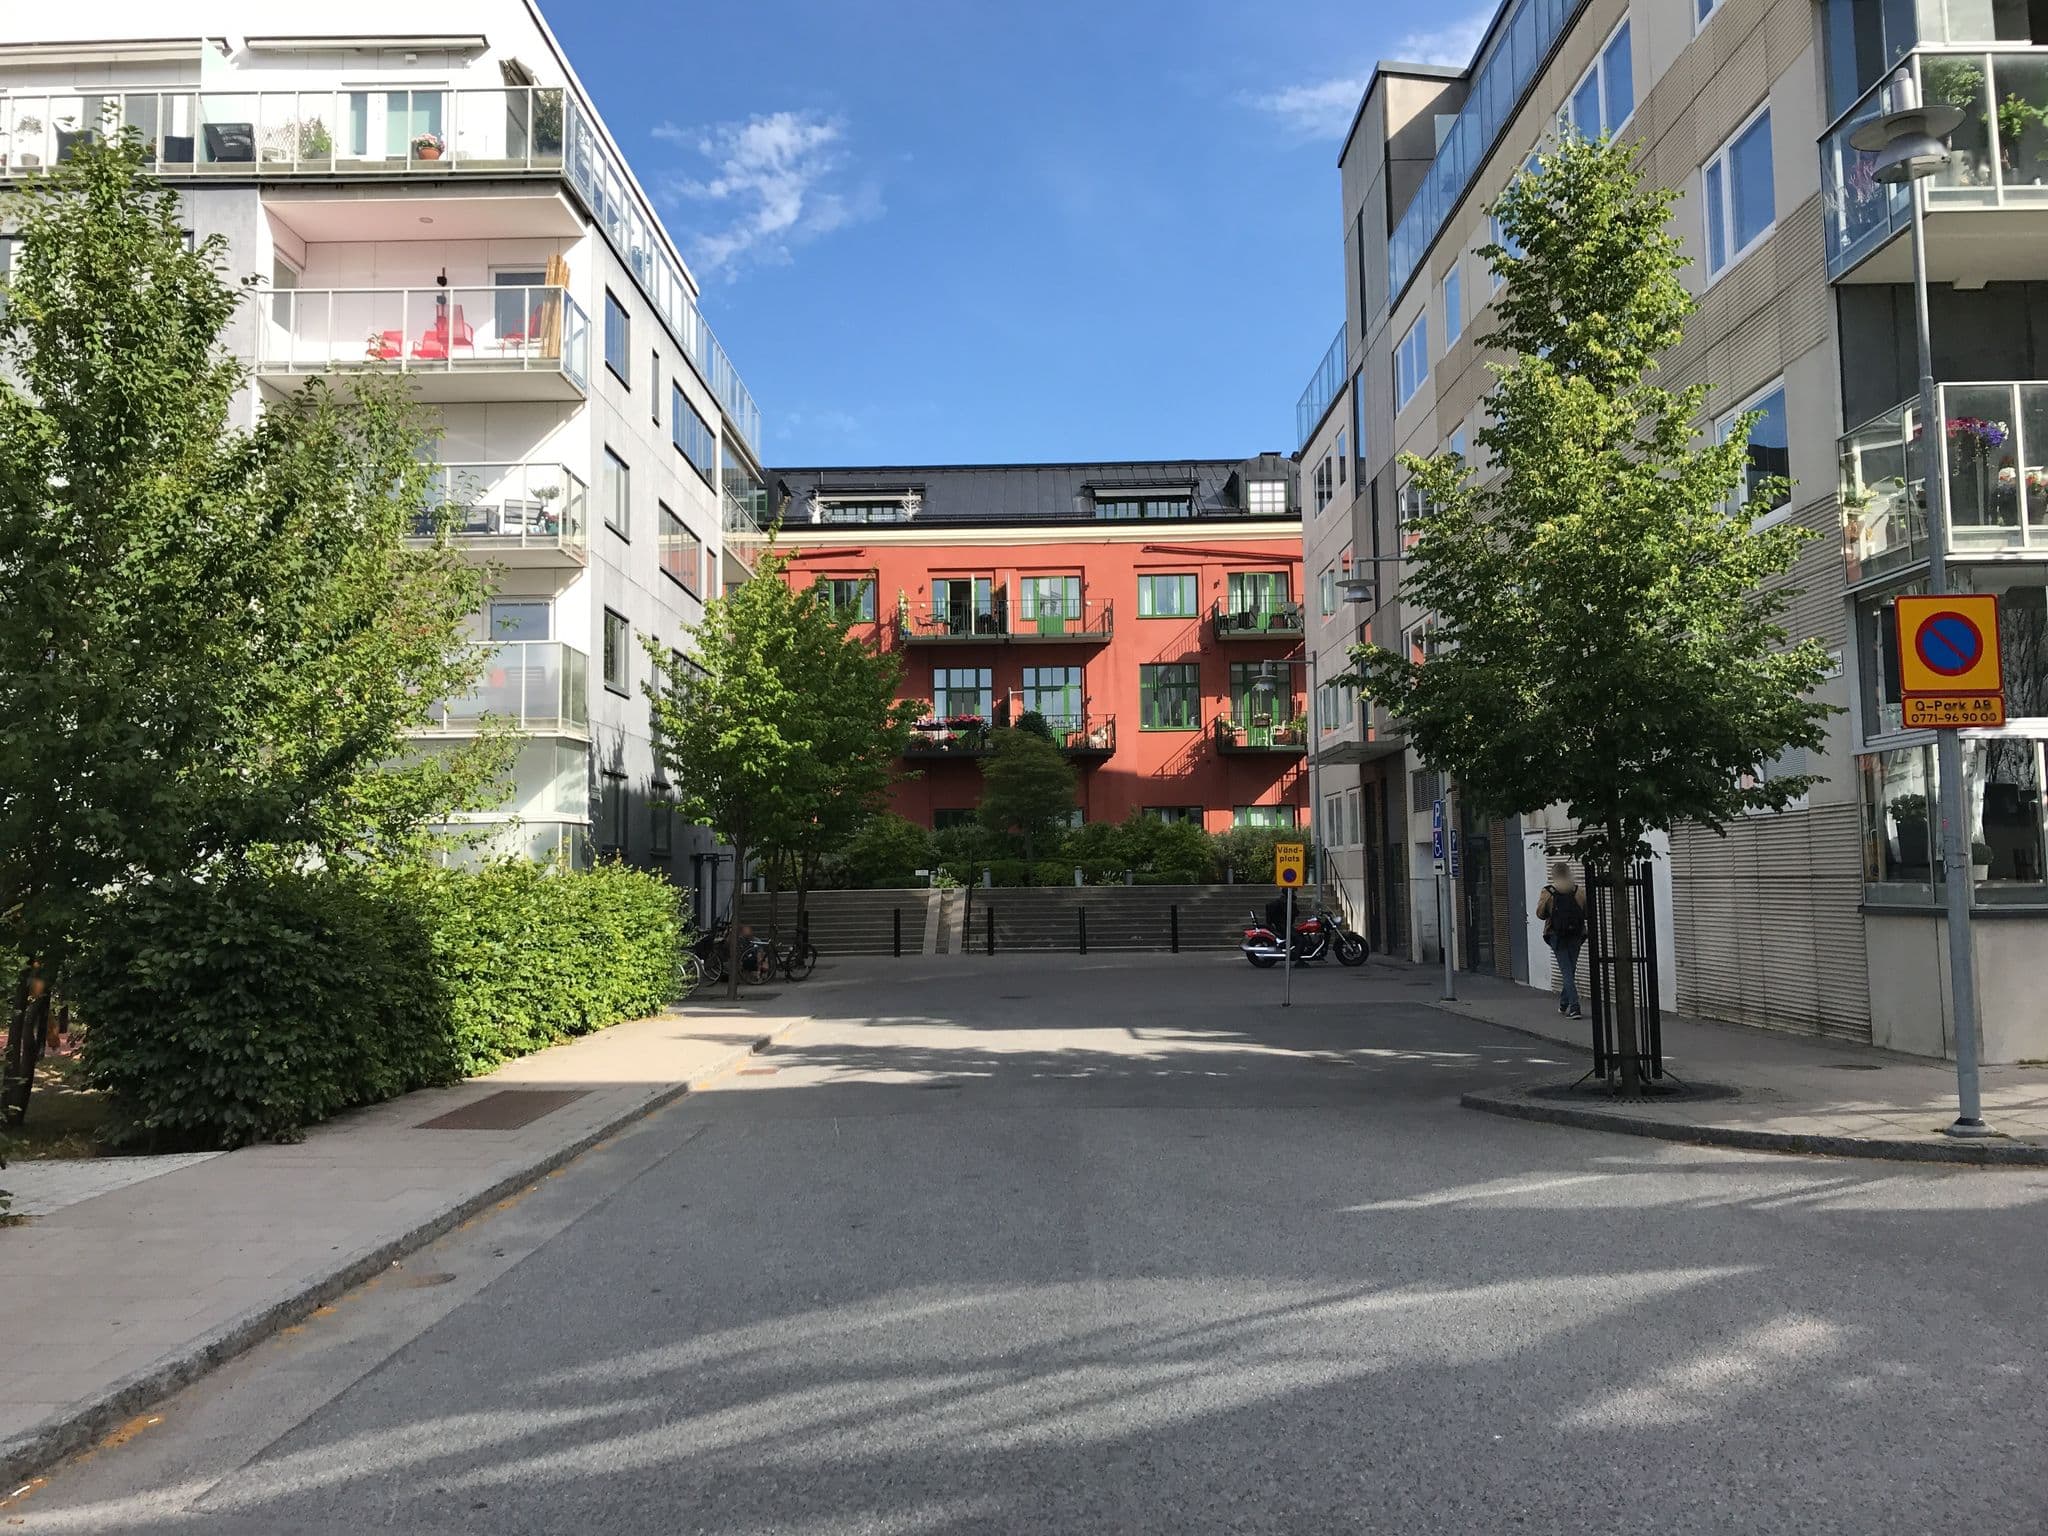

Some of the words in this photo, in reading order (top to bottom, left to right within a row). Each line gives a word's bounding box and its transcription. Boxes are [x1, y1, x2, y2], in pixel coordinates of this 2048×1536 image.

[1915, 700, 1966, 711] Q-Park
[1973, 699, 1992, 710] AB
[1911, 713, 1959, 723] 0771-96
[1962, 713, 1978, 722] 90
[1980, 713, 1996, 722] 00
[1434, 802, 1440, 827] P
[1280, 855, 1300, 863] plats
